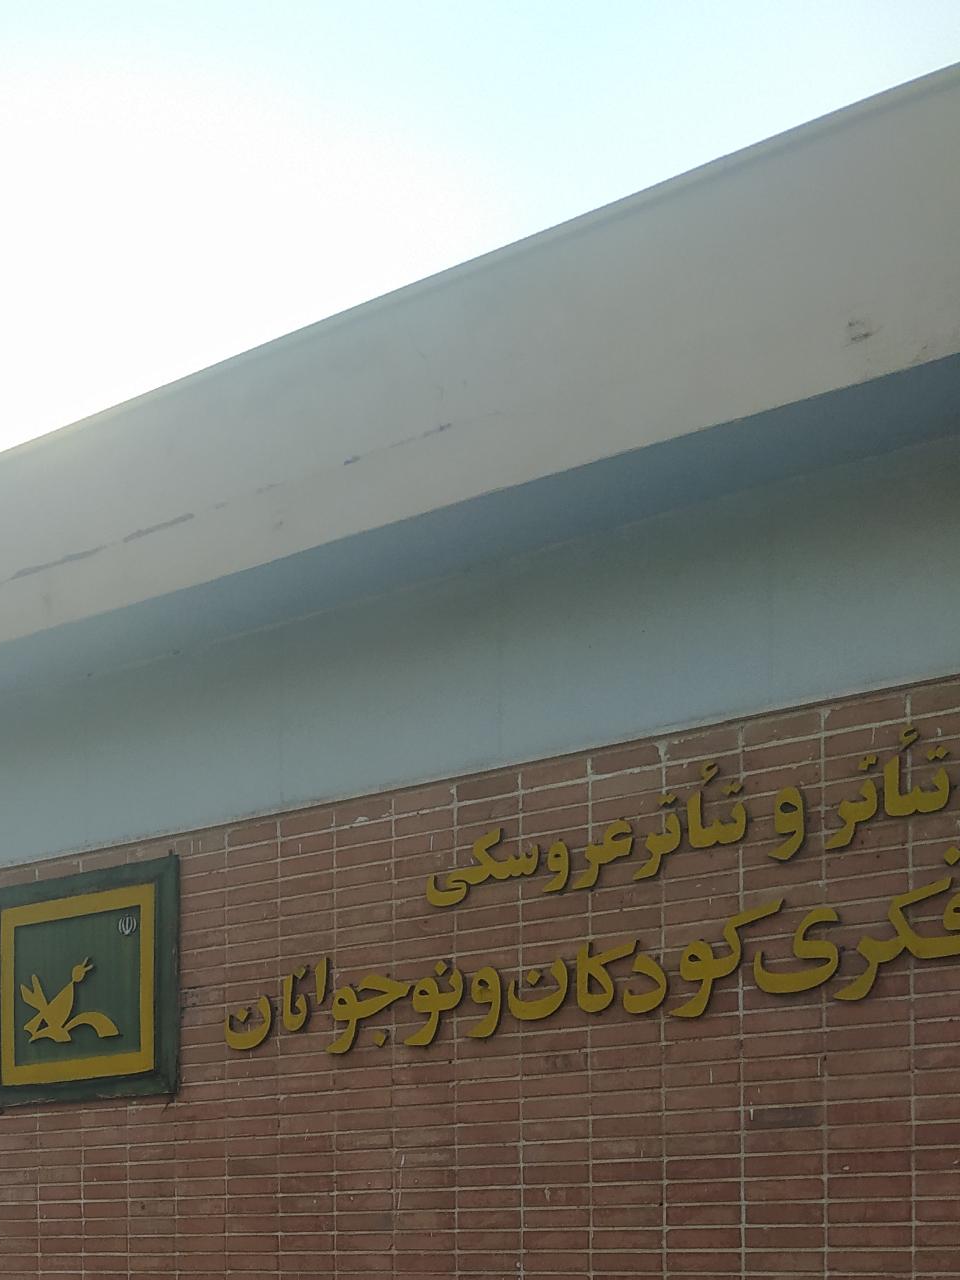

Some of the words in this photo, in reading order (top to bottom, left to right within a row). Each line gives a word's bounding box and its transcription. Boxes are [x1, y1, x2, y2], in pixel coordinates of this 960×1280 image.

[426, 819, 633, 906] عروسکی
[767, 785, 806, 862] و
[508, 897, 784, 1020] کودکان
[224, 957, 463, 1054] نوجوانان
